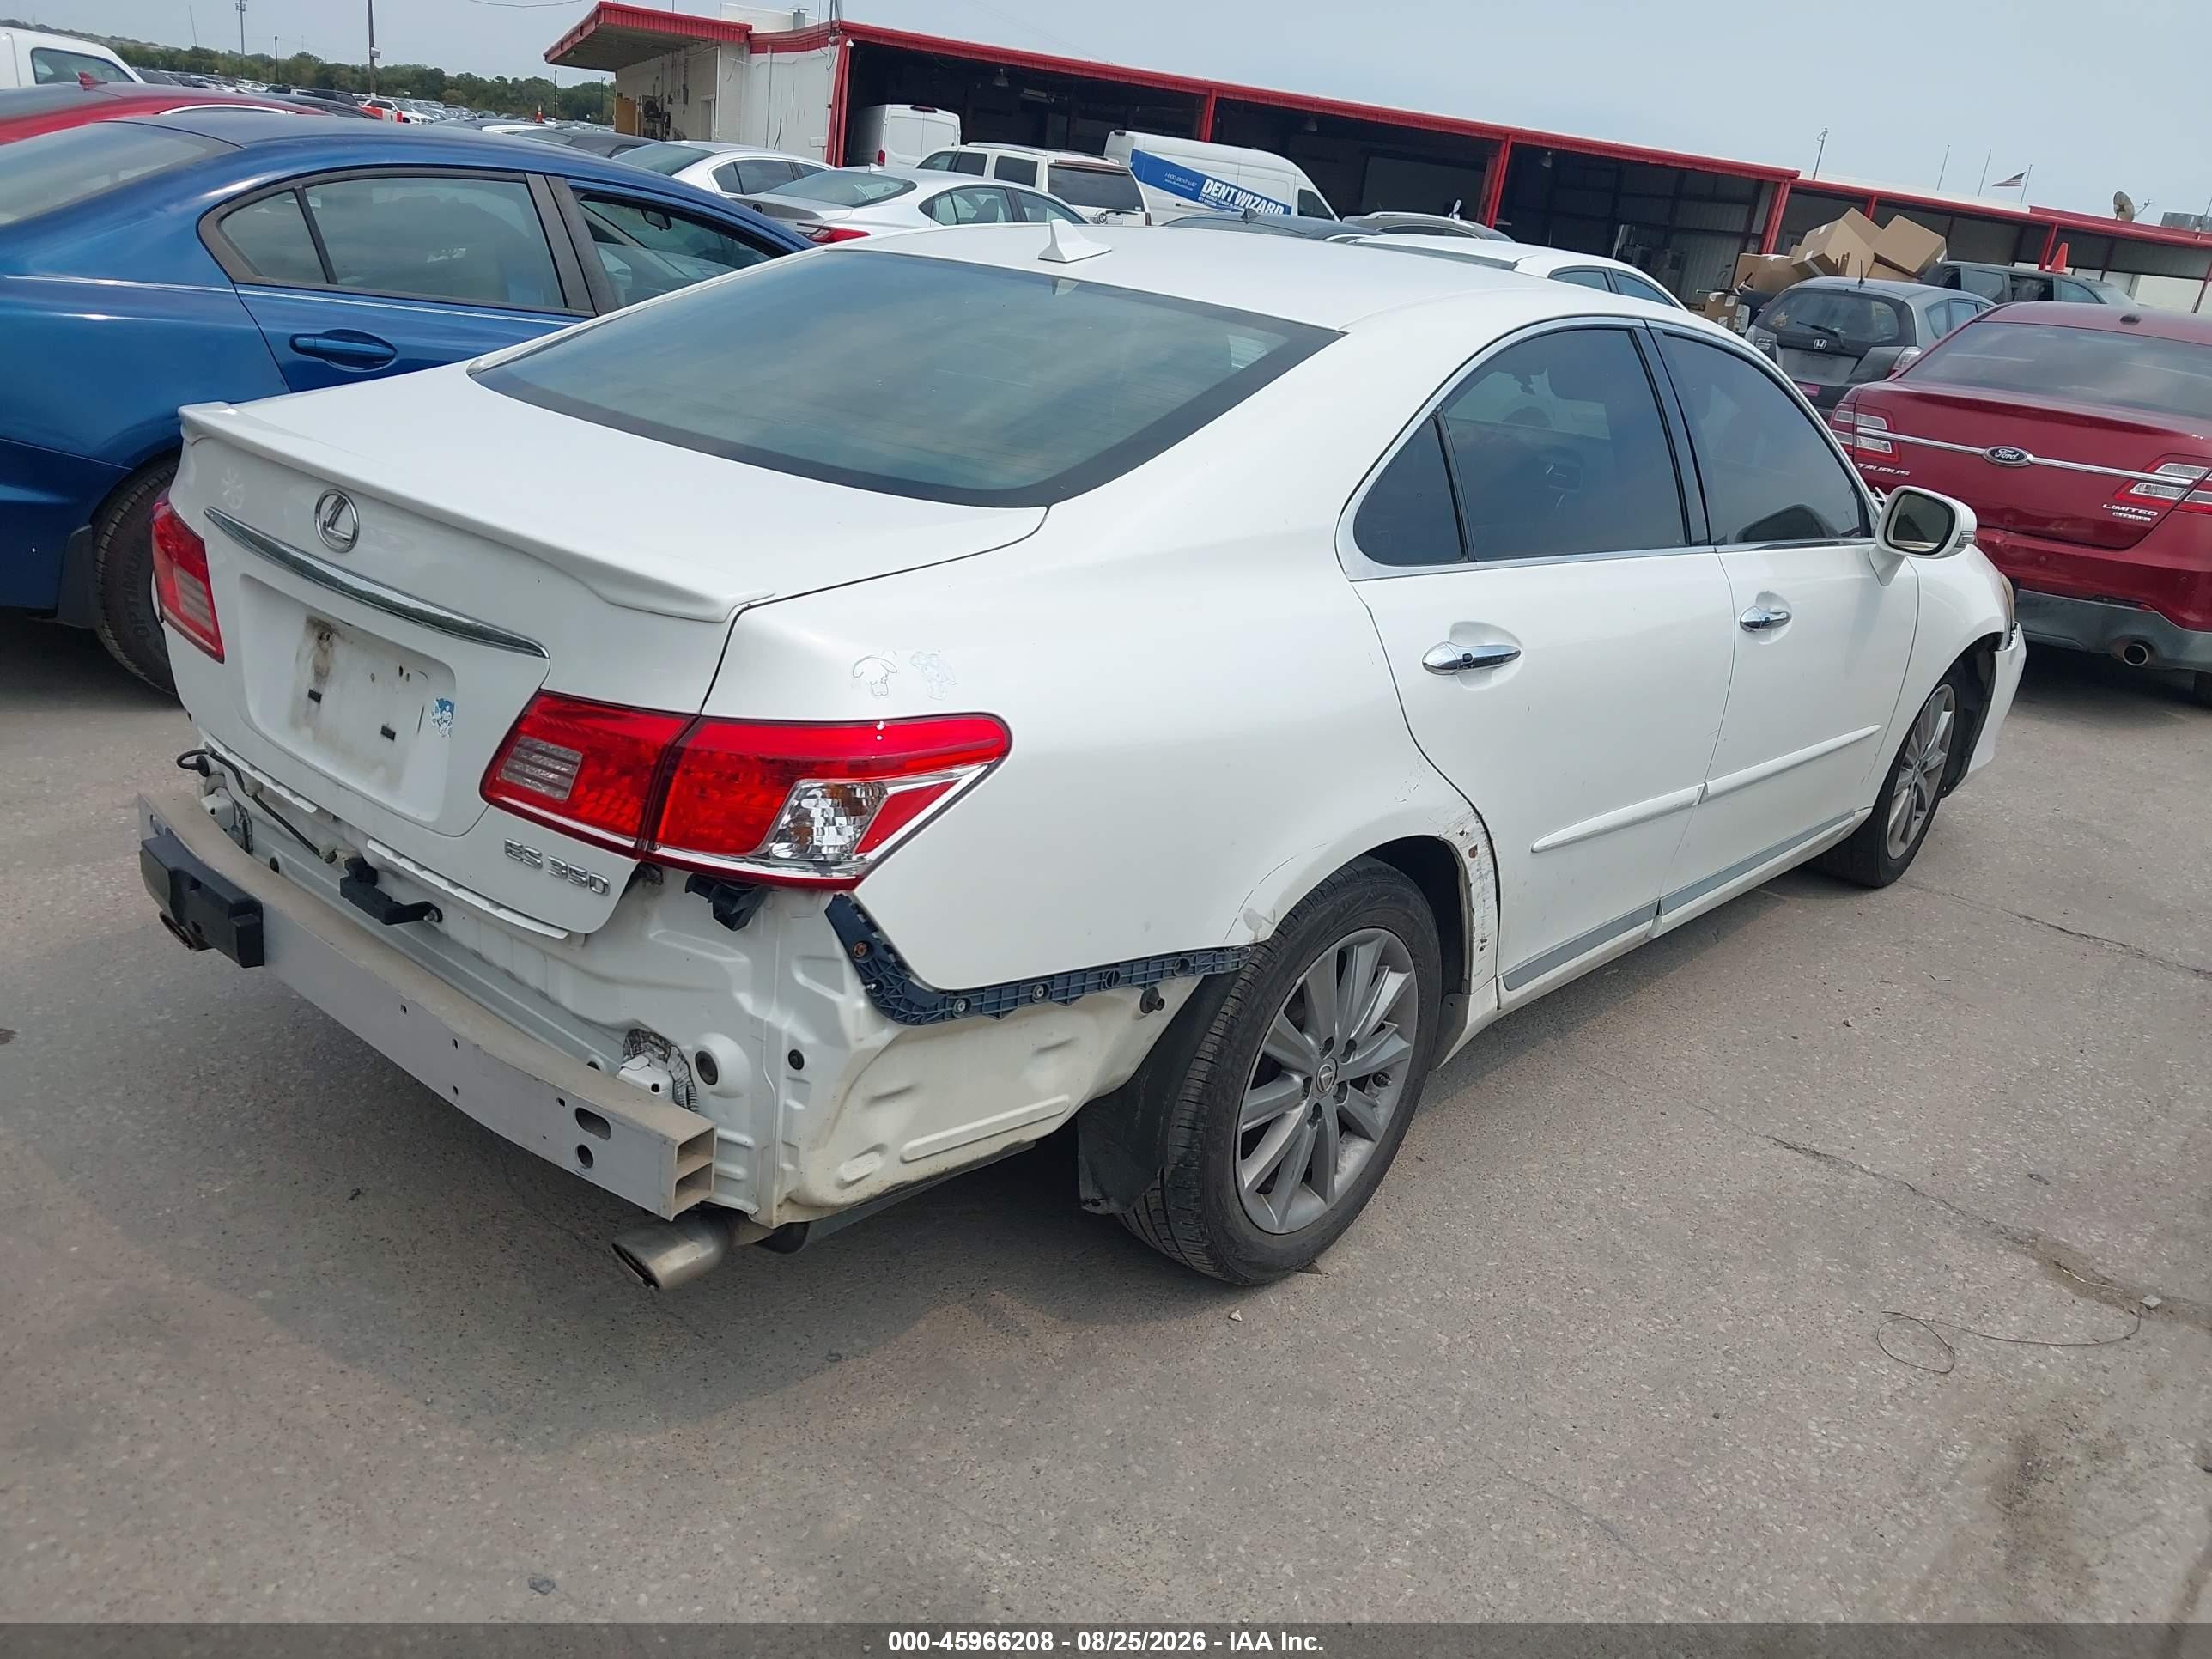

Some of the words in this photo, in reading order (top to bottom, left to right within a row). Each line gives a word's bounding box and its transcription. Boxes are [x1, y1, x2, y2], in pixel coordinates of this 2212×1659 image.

[1994, 448, 2020, 461] Ford
[1857, 463, 1911, 476] TAURUS
[2101, 503, 2159, 516] LIMITED
[504, 837, 543, 869] ES
[547, 855, 611, 896] 350
